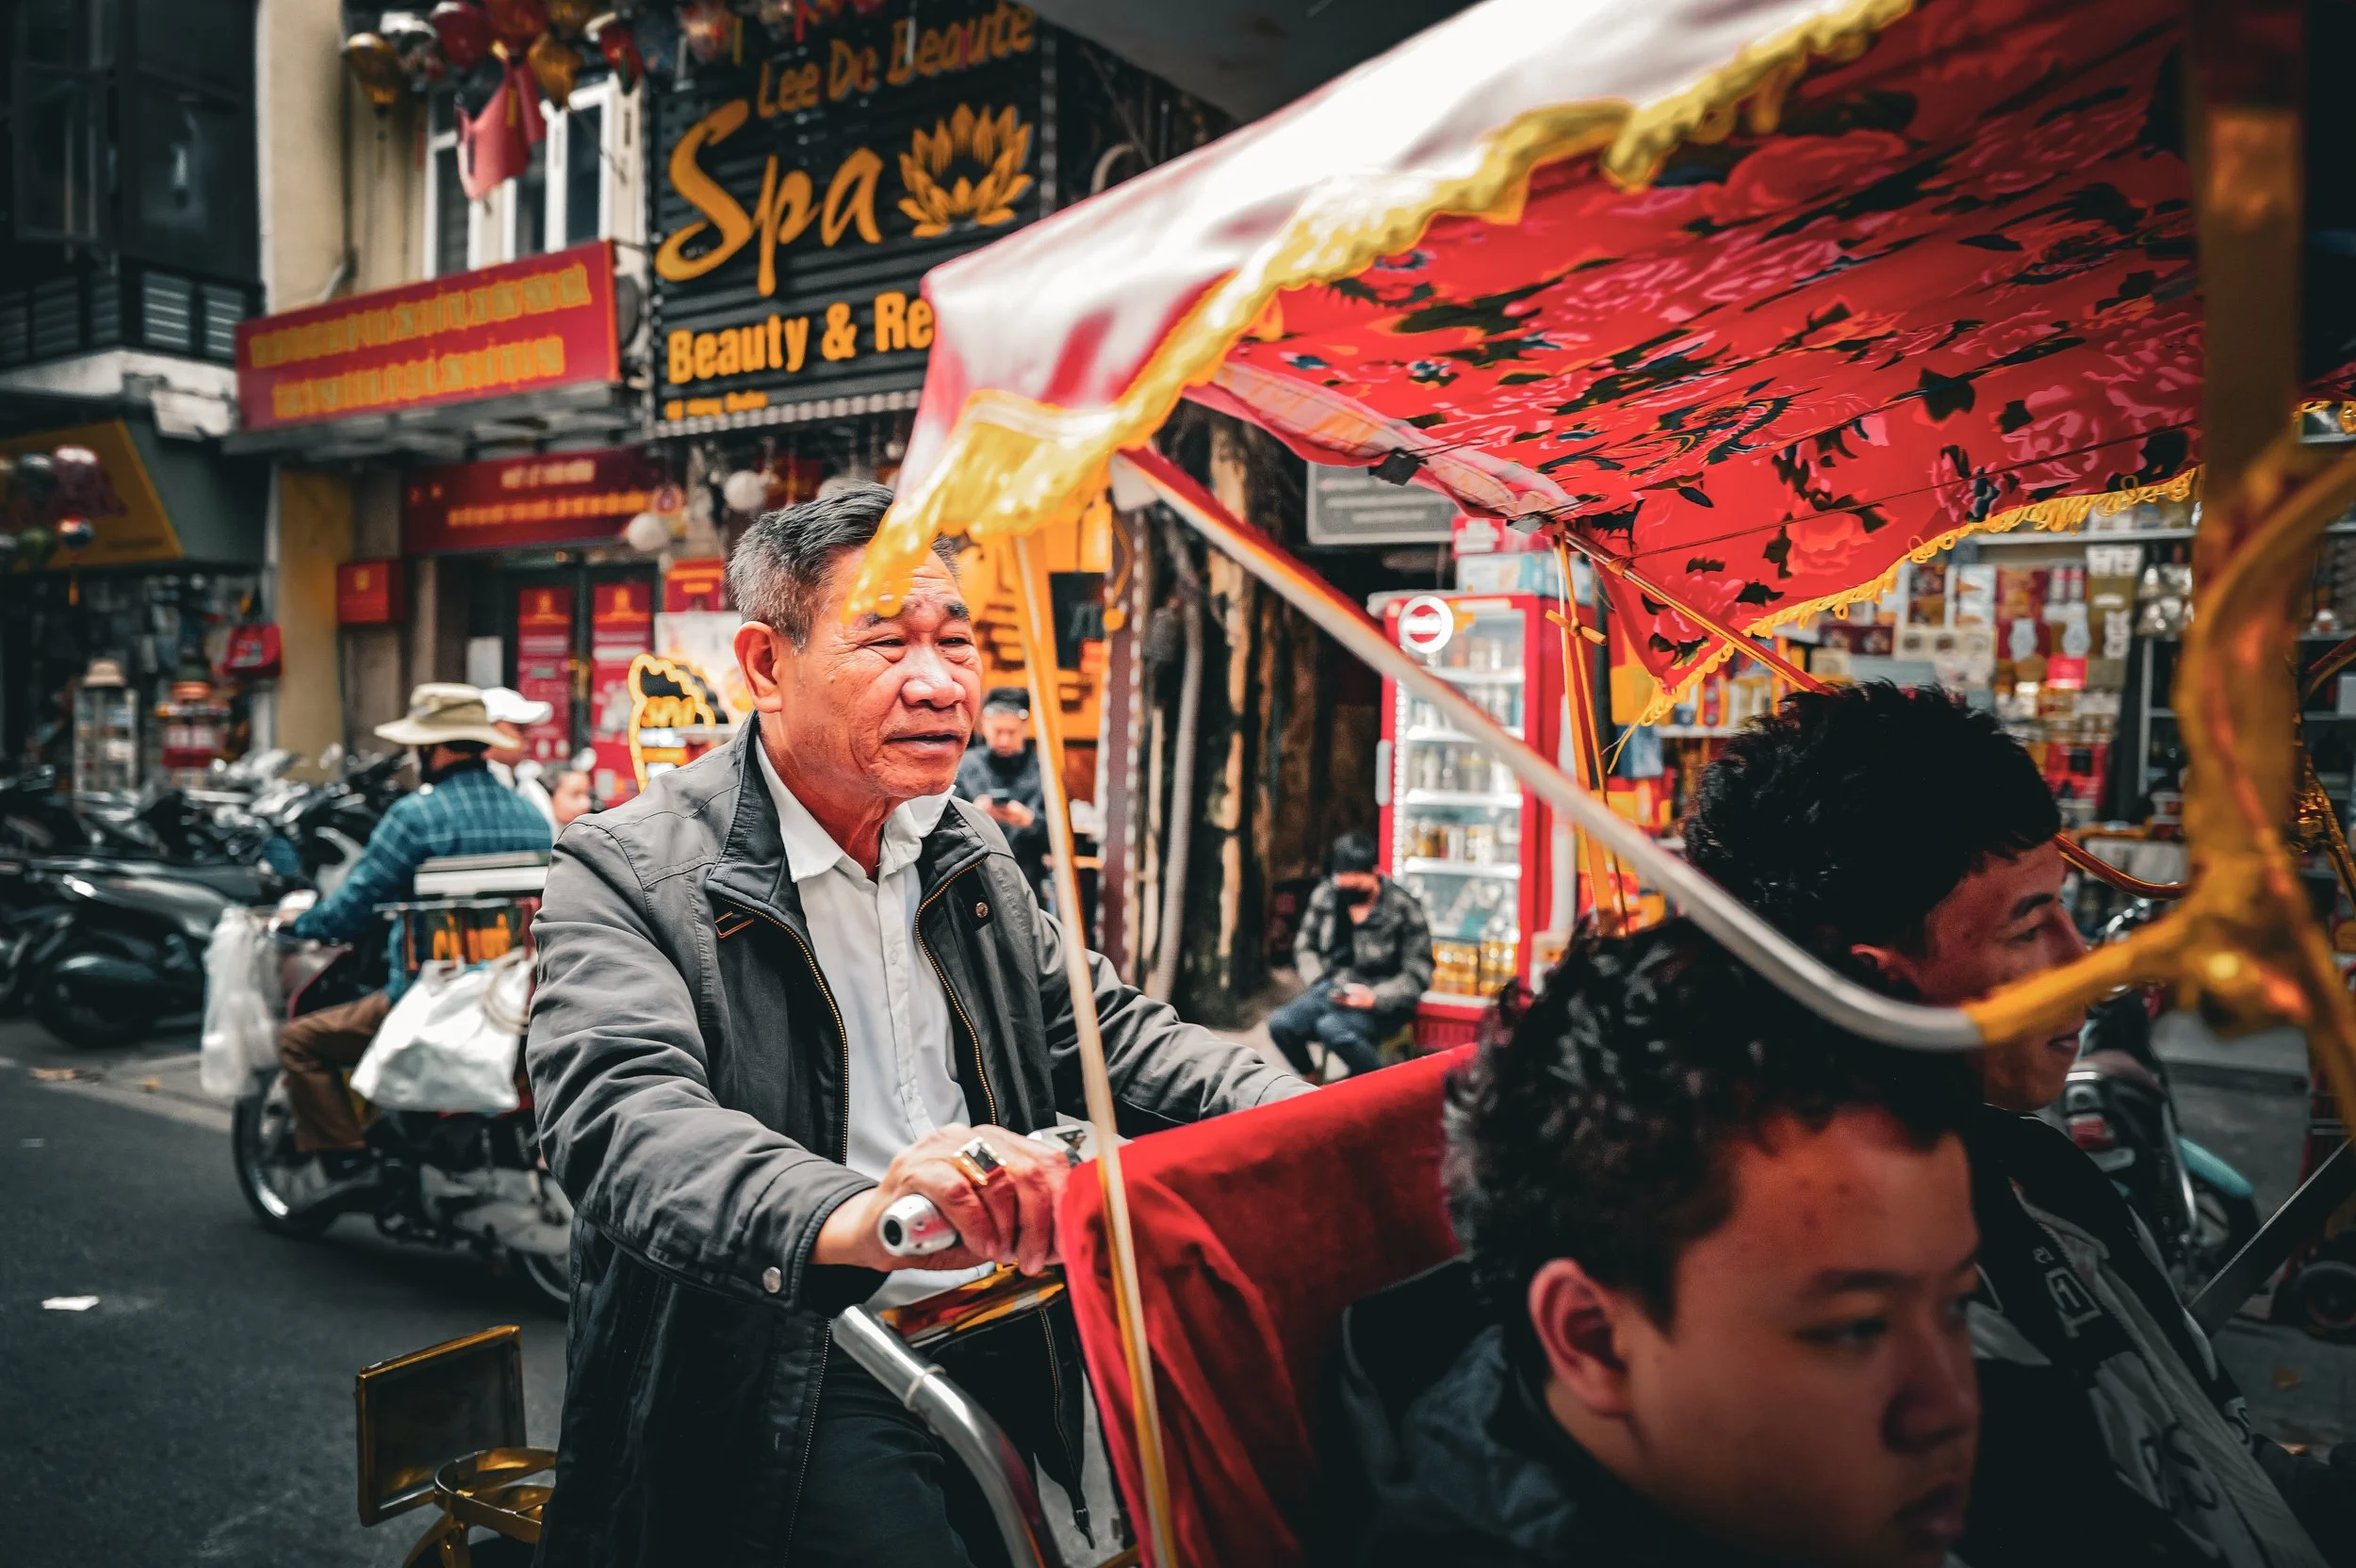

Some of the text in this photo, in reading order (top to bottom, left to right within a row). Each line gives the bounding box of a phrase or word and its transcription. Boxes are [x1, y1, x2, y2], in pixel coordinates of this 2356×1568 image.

[758, 60, 819, 119] Lee
[655, 99, 883, 297] Spa
[667, 291, 935, 384] Beauty & Re
